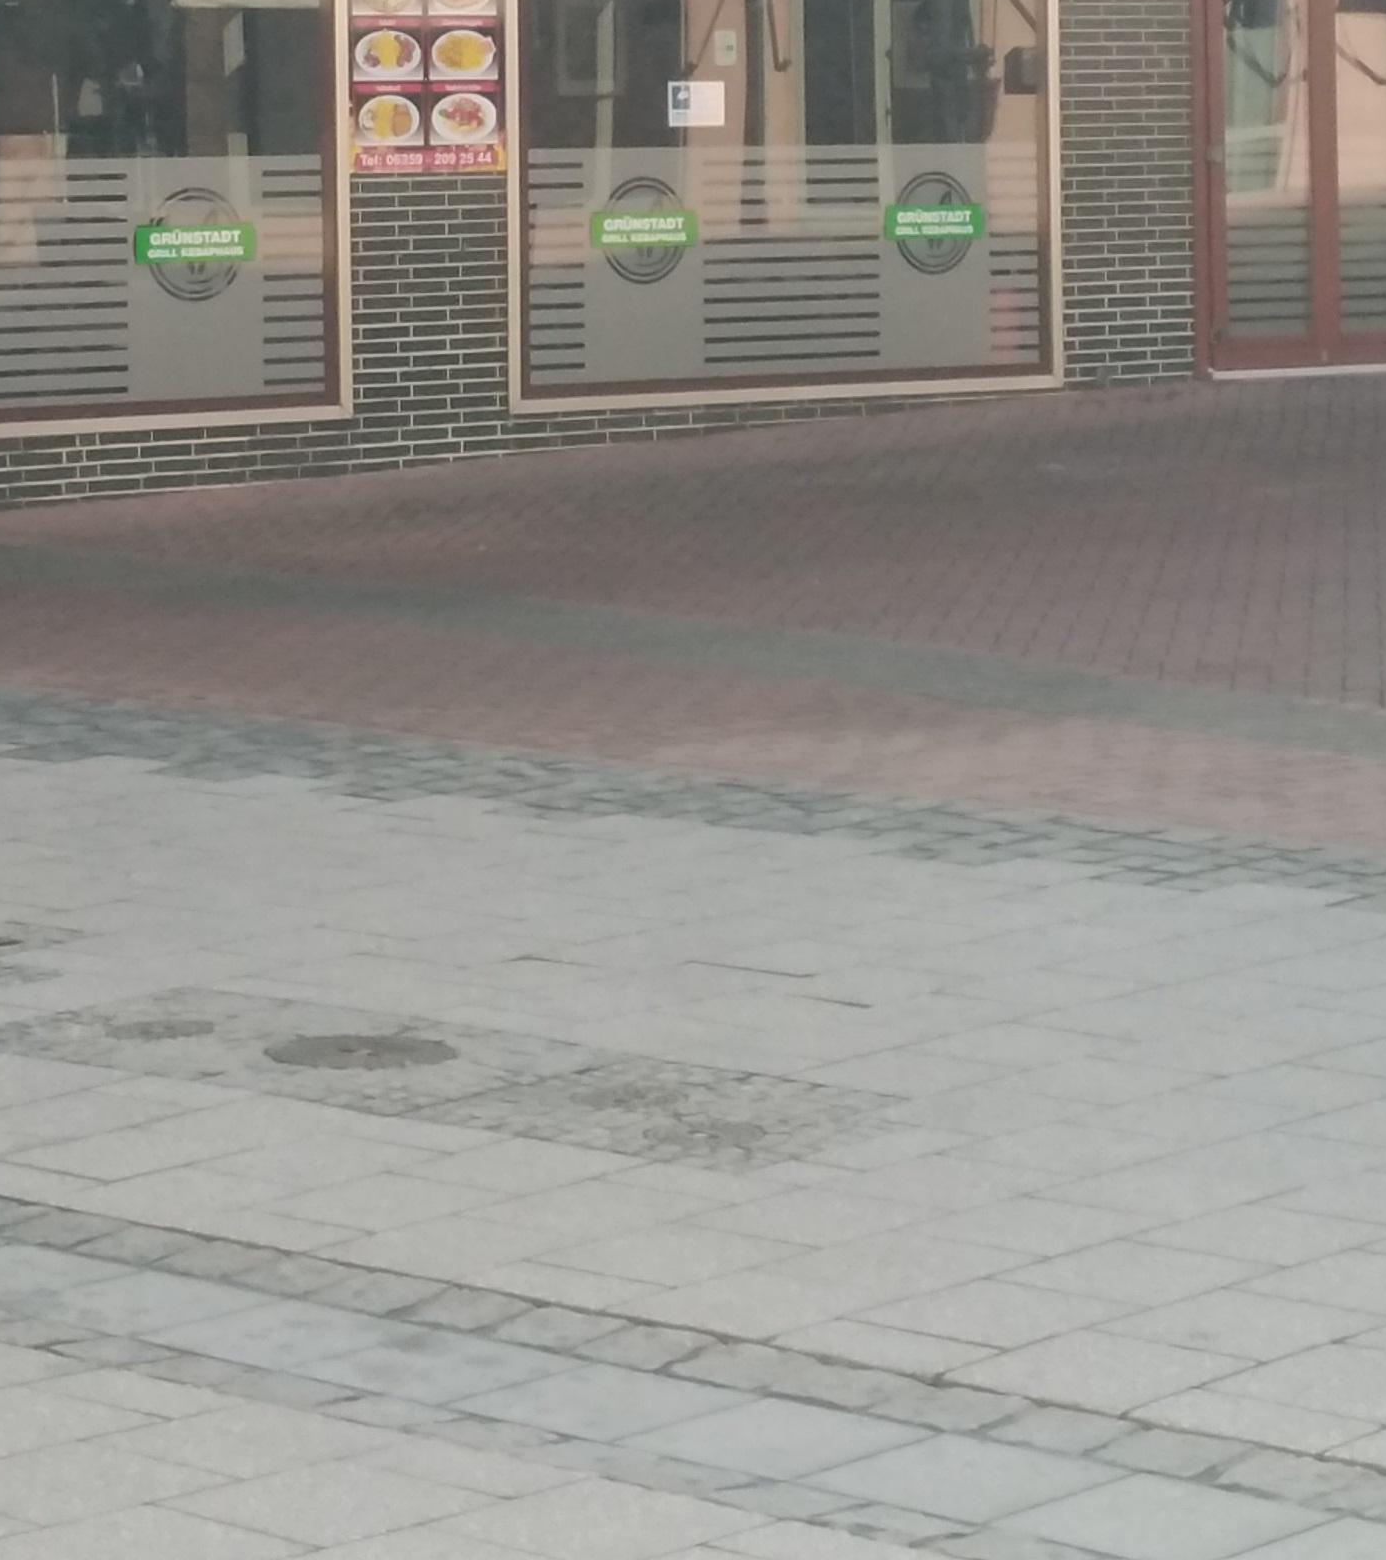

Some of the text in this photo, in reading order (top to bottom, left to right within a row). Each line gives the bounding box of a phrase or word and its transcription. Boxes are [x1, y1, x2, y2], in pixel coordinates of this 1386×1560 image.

[603, 216, 685, 231] GRÜNSTADT
[896, 209, 971, 224] GRÜNSTADT
[149, 229, 241, 245] GRÜNSTADT
